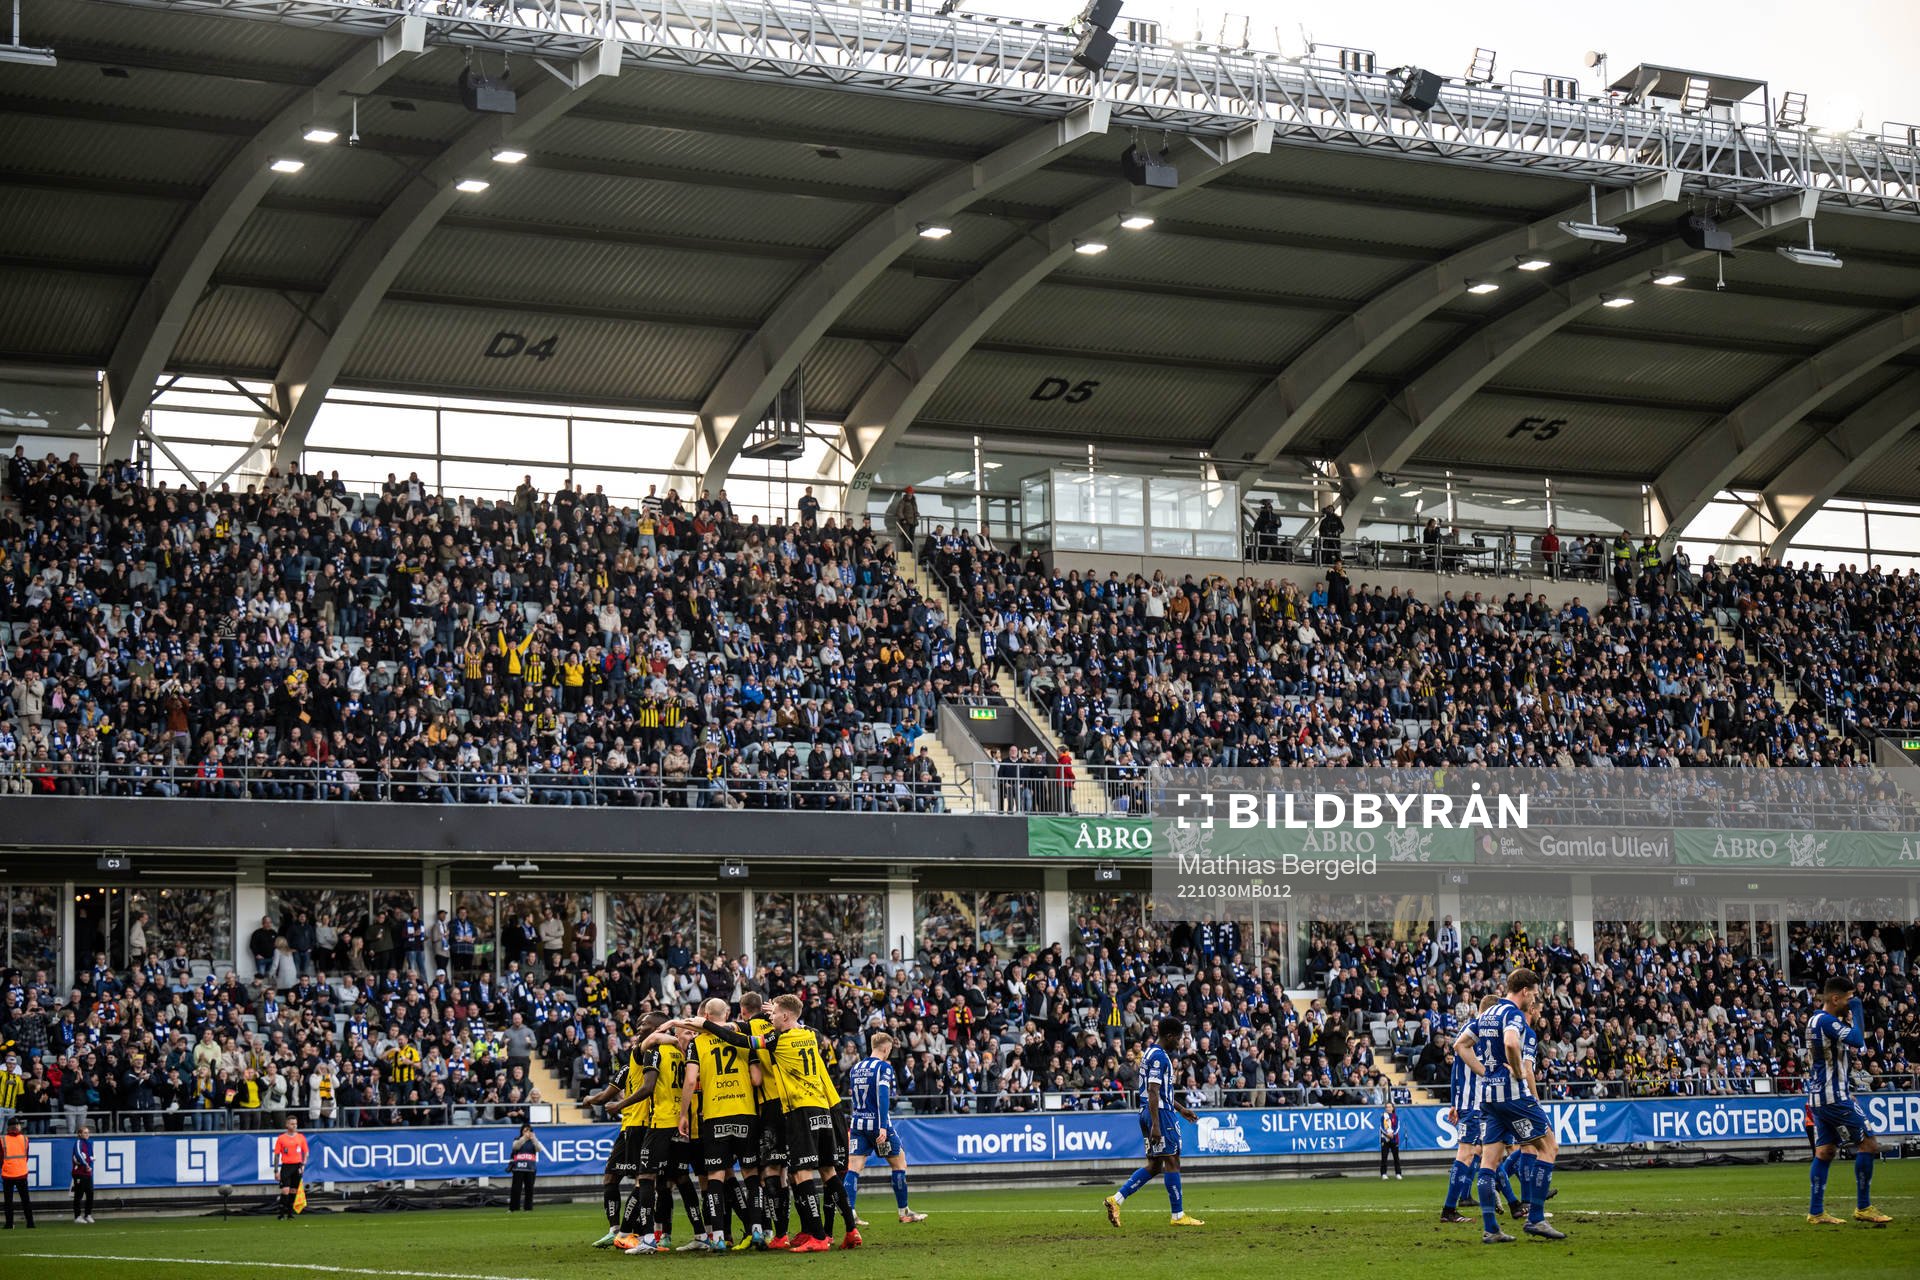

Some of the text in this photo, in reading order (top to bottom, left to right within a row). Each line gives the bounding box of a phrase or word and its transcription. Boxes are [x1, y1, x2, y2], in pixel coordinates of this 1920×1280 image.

[484, 331, 559, 361] D4
[1029, 377, 1100, 403] D5
[1506, 417, 1568, 440] F5
[1074, 822, 1153, 849] ÅBRO
[1302, 828, 1375, 854] ÅBRO
[1500, 837, 1515, 847] Got
[1539, 835, 1669, 858] Gamla Ullevi
[1712, 834, 1777, 859] ÅBRO
[108, 859, 120, 868] C3
[1501, 846, 1524, 856] Event
[729, 867, 740, 876] C4
[1103, 871, 1113, 879] C5
[710, 1046, 739, 1076] 12
[798, 1047, 817, 1077] 11
[1484, 1039, 1497, 1073] 4
[716, 1079, 739, 1089] brion
[853, 1084, 870, 1110] 17
[1261, 1111, 1375, 1133] SILFVERLOK
[1653, 1103, 1805, 1137] IFK GÖTEBOR
[1869, 1096, 1920, 1133] SER
[715, 1124, 748, 1137] DEMO
[957, 1124, 1113, 1154] morris law.
[1292, 1136, 1346, 1150] INVEST
[323, 1138, 615, 1169] NORDICWELNESS
